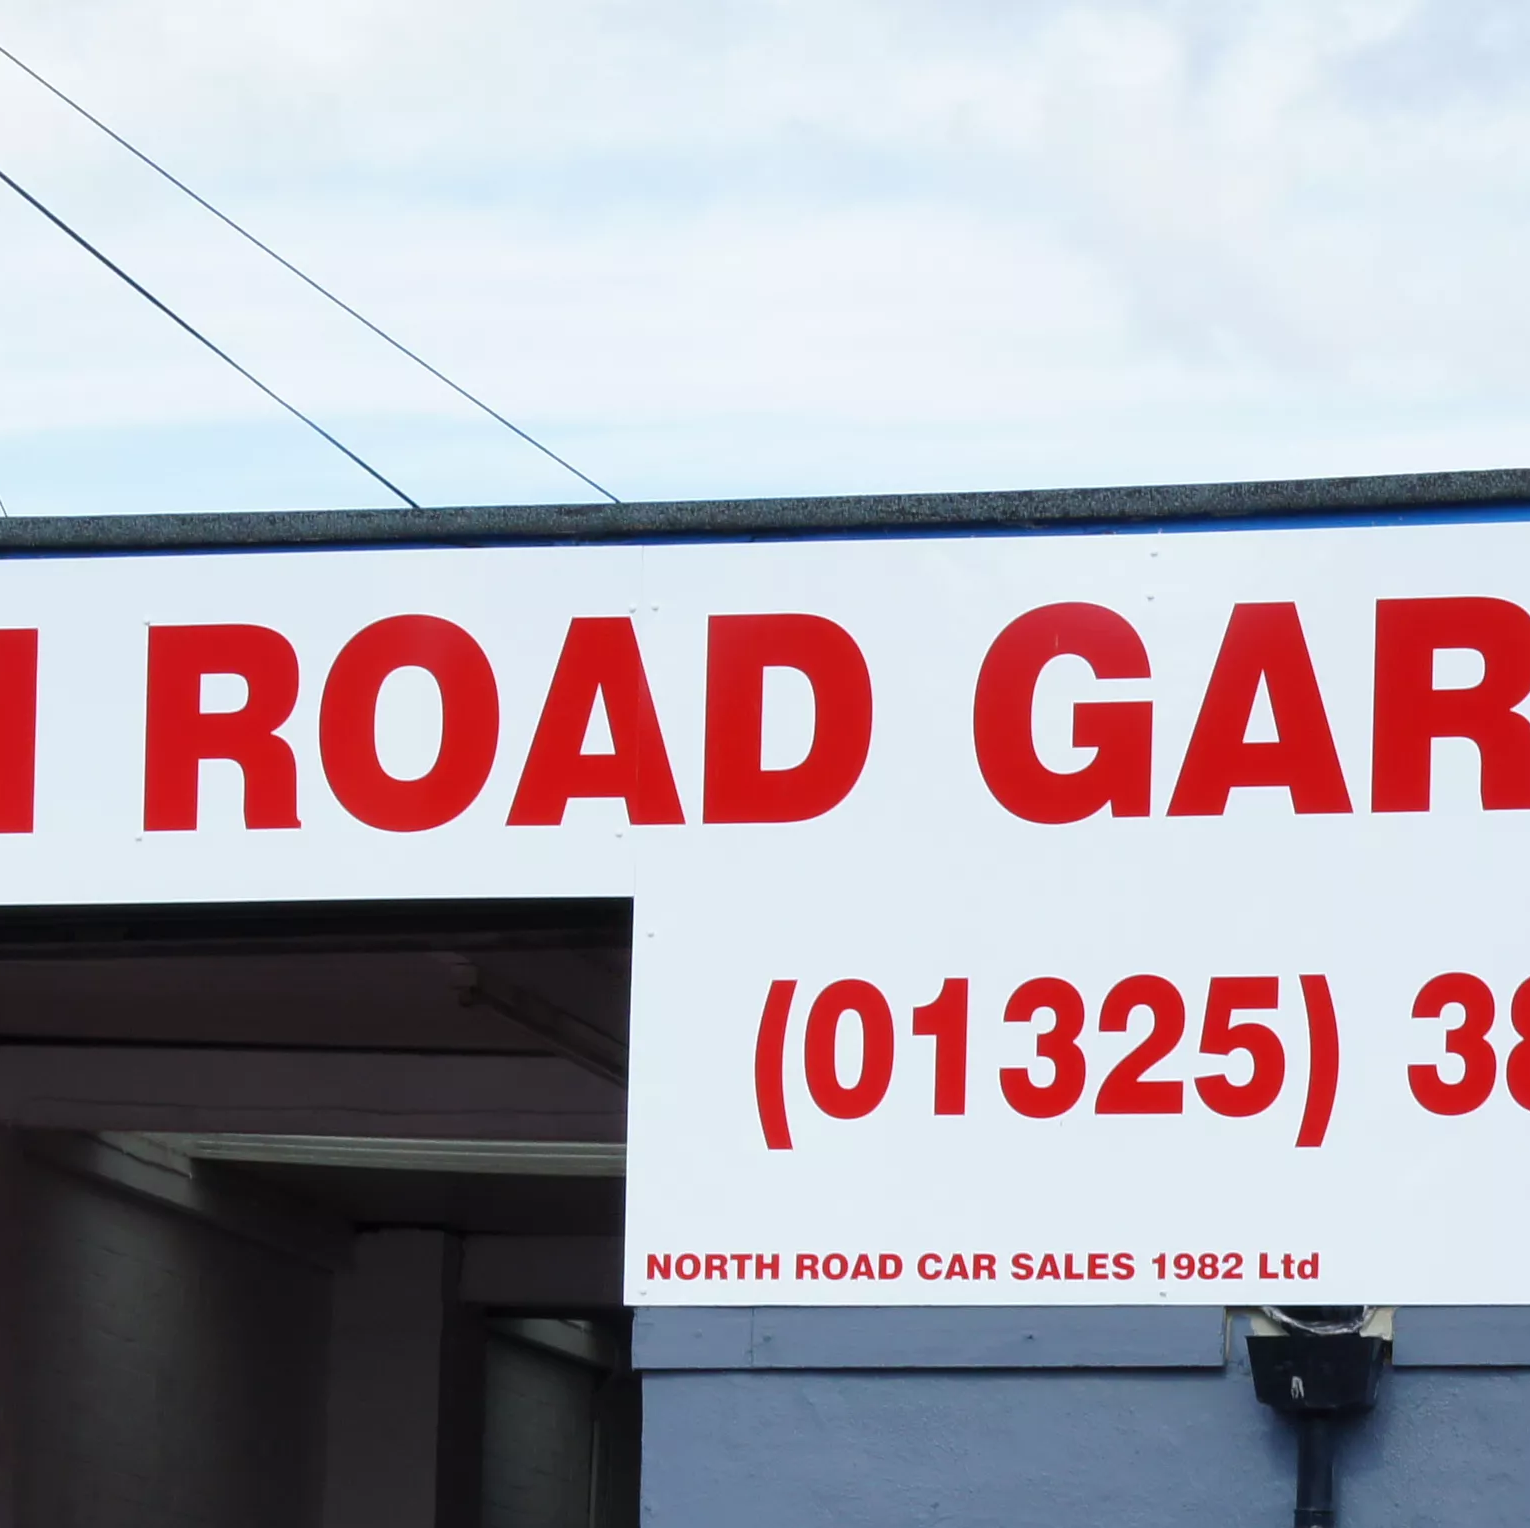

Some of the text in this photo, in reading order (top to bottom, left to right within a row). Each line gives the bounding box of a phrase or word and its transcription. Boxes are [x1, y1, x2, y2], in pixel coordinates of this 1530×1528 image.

[145, 614, 873, 832] ROAD
[755, 975, 1339, 1149] (01325)
[648, 1253, 1319, 1280] NORTH ROAD CAR SALES 1982 Ltd
